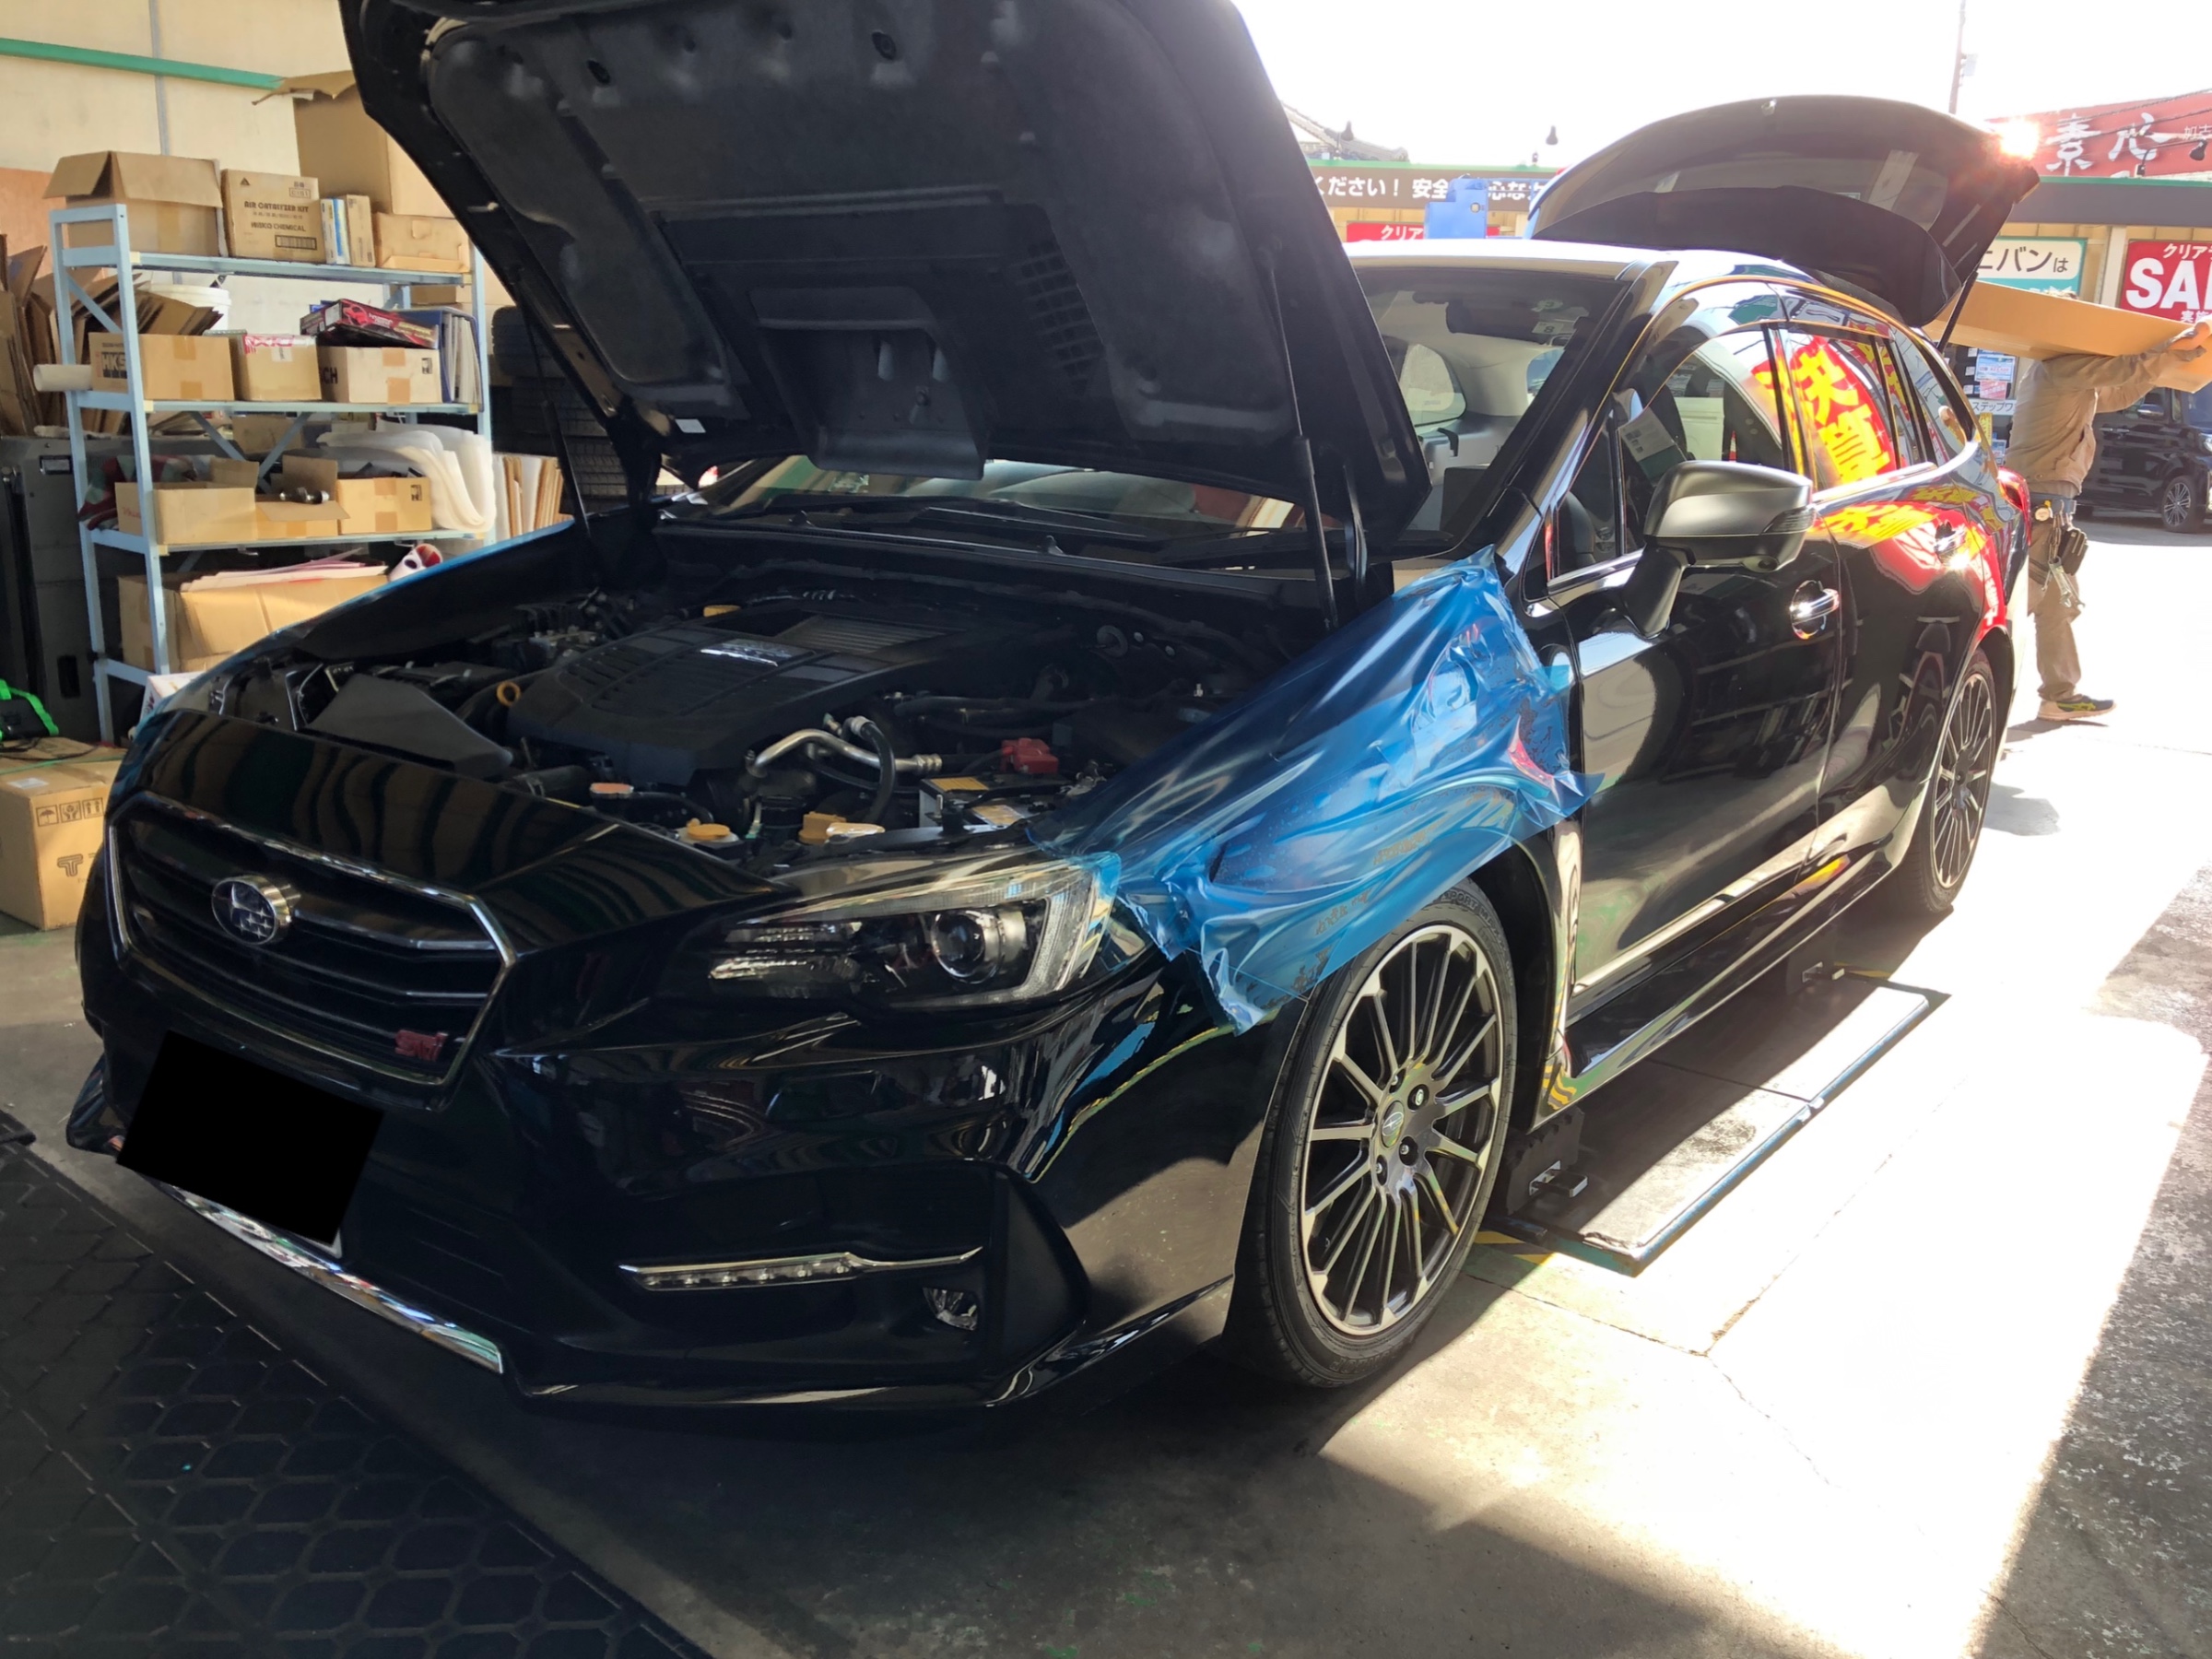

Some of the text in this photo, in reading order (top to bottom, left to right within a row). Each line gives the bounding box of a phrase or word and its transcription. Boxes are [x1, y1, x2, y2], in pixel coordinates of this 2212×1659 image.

[273, 222, 307, 232] CHEMICAL
[2163, 243, 2212, 260] クリア
[1972, 401, 2016, 412] ステップワ
